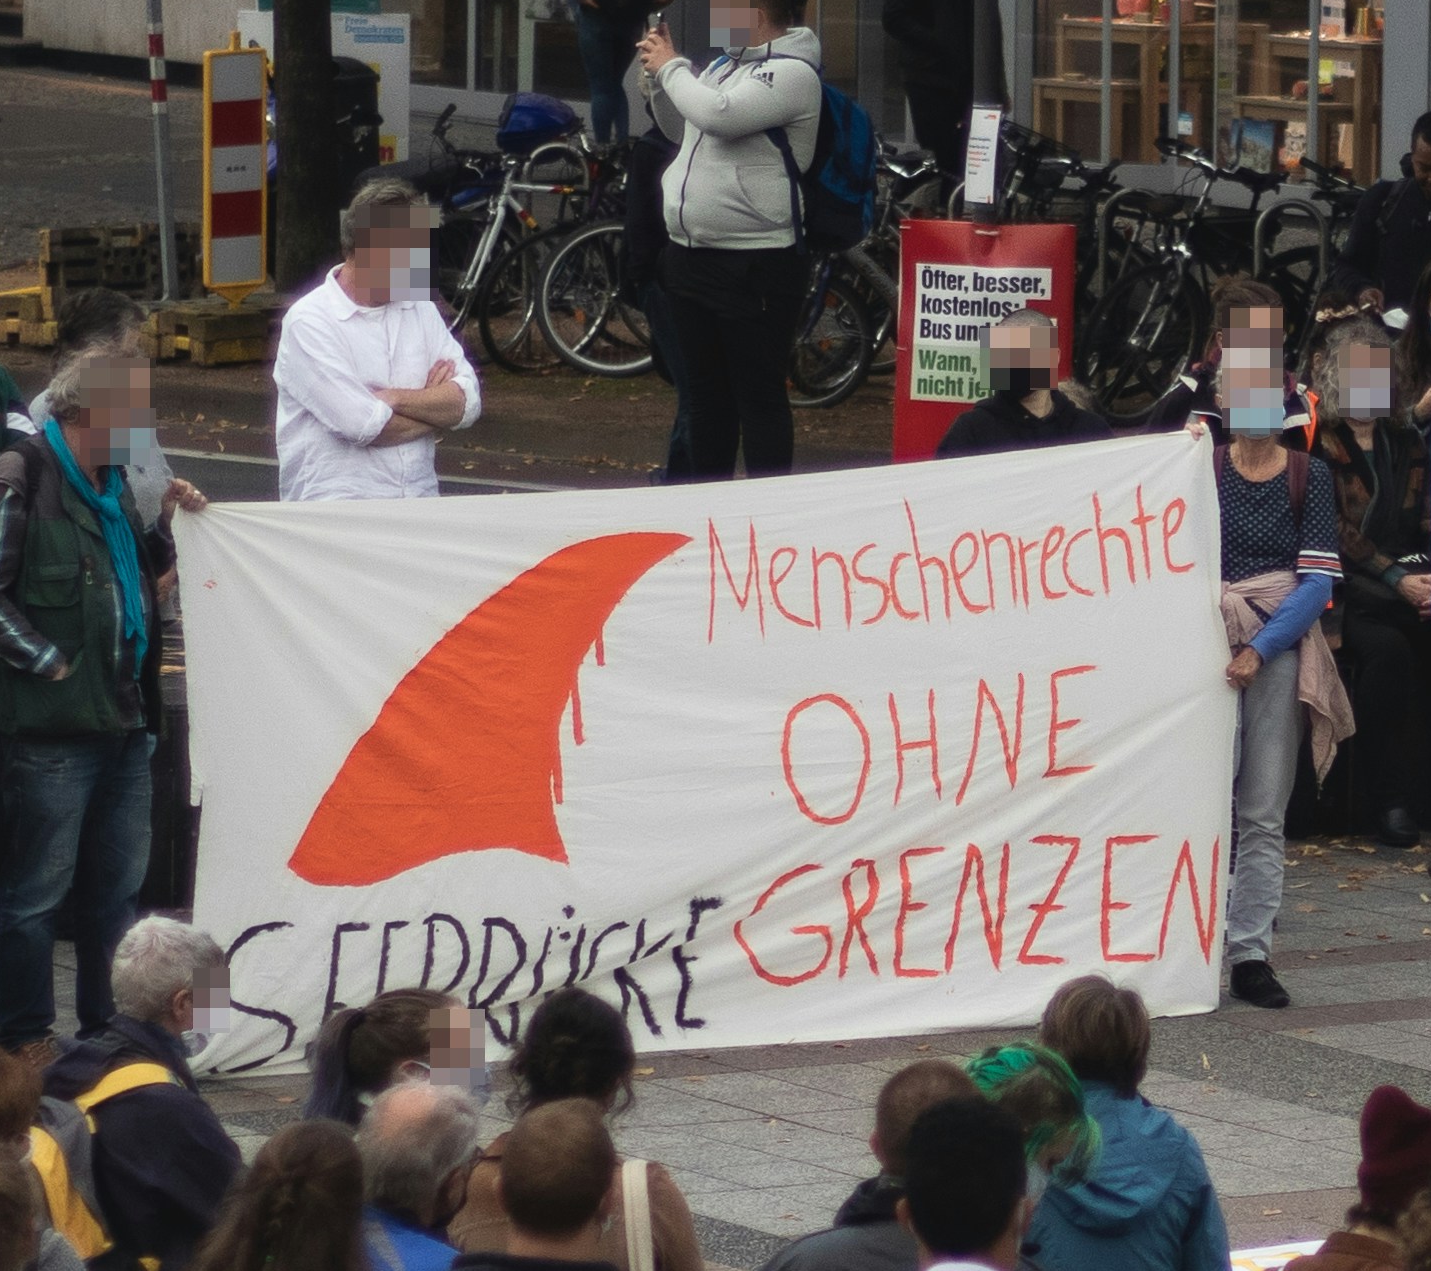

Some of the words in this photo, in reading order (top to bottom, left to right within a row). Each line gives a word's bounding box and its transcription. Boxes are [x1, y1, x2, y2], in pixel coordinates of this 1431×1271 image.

[921, 265, 968, 293] Öfter,
[972, 272, 1046, 296] besser,
[920, 318, 952, 339] Bus
[918, 349, 977, 375] Wann,
[916, 375, 964, 397] nicht
[707, 484, 1196, 644] Menschenrechte
[781, 664, 1097, 826] OHNE
[733, 834, 1220, 988] GRENZEN
